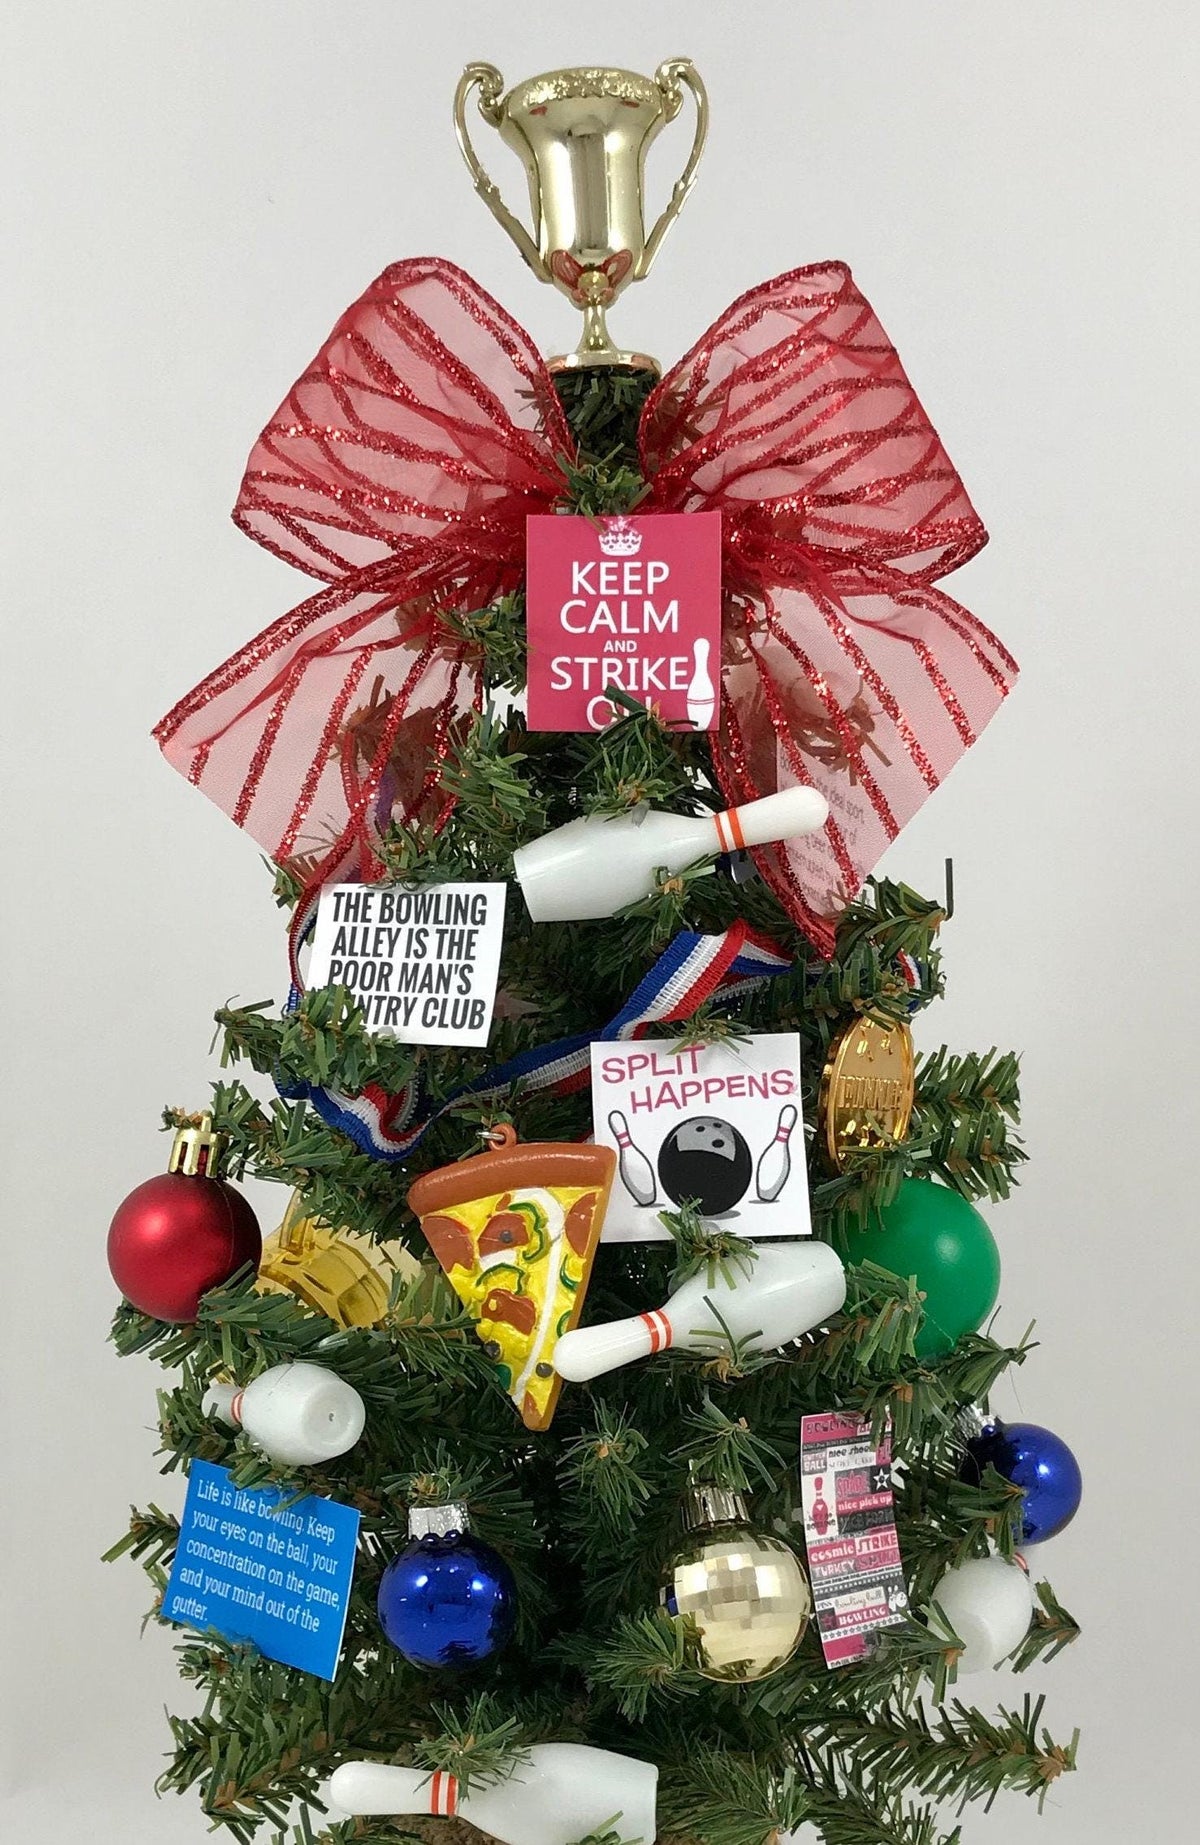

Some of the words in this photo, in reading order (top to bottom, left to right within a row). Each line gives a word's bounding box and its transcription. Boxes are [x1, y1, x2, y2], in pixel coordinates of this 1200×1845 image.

[572, 561, 670, 595] KEEP
[560, 600, 679, 634] CALM
[603, 640, 638, 653] AND
[551, 656, 689, 691] STRIKE
[333, 892, 375, 923] THE
[379, 893, 488, 926] BOWLING
[331, 926, 401, 958] ALLEY
[405, 927, 430, 959] IS
[435, 928, 479, 961] THE
[329, 960, 393, 992] POOR
[398, 962, 474, 995] MAN'S
[422, 997, 486, 1030] CLUB
[602, 1045, 706, 1084] SPLIT
[631, 1069, 794, 1114] HAPPENS
[197, 1479, 220, 1502] Life
[221, 1486, 232, 1506] is
[233, 1491, 256, 1514] like
[307, 1515, 335, 1546] Keep
[191, 1510, 219, 1532] your
[220, 1520, 247, 1542] eyes
[249, 1530, 263, 1548] on
[267, 1533, 286, 1555] the
[287, 1538, 309, 1567] ball,
[312, 1552, 338, 1576] your
[186, 1538, 267, 1579] concentration
[268, 1567, 284, 1586] on
[286, 1571, 305, 1594] the
[305, 1583, 340, 1611] game,
[172, 1595, 208, 1622] gutter.
[180, 1567, 204, 1588] and
[202, 1575, 231, 1598] your
[232, 1585, 265, 1611] mind
[265, 1598, 287, 1620] out
[286, 1605, 302, 1626] of
[301, 1609, 320, 1633] the
[838, 1606, 886, 1625] BOWLING
